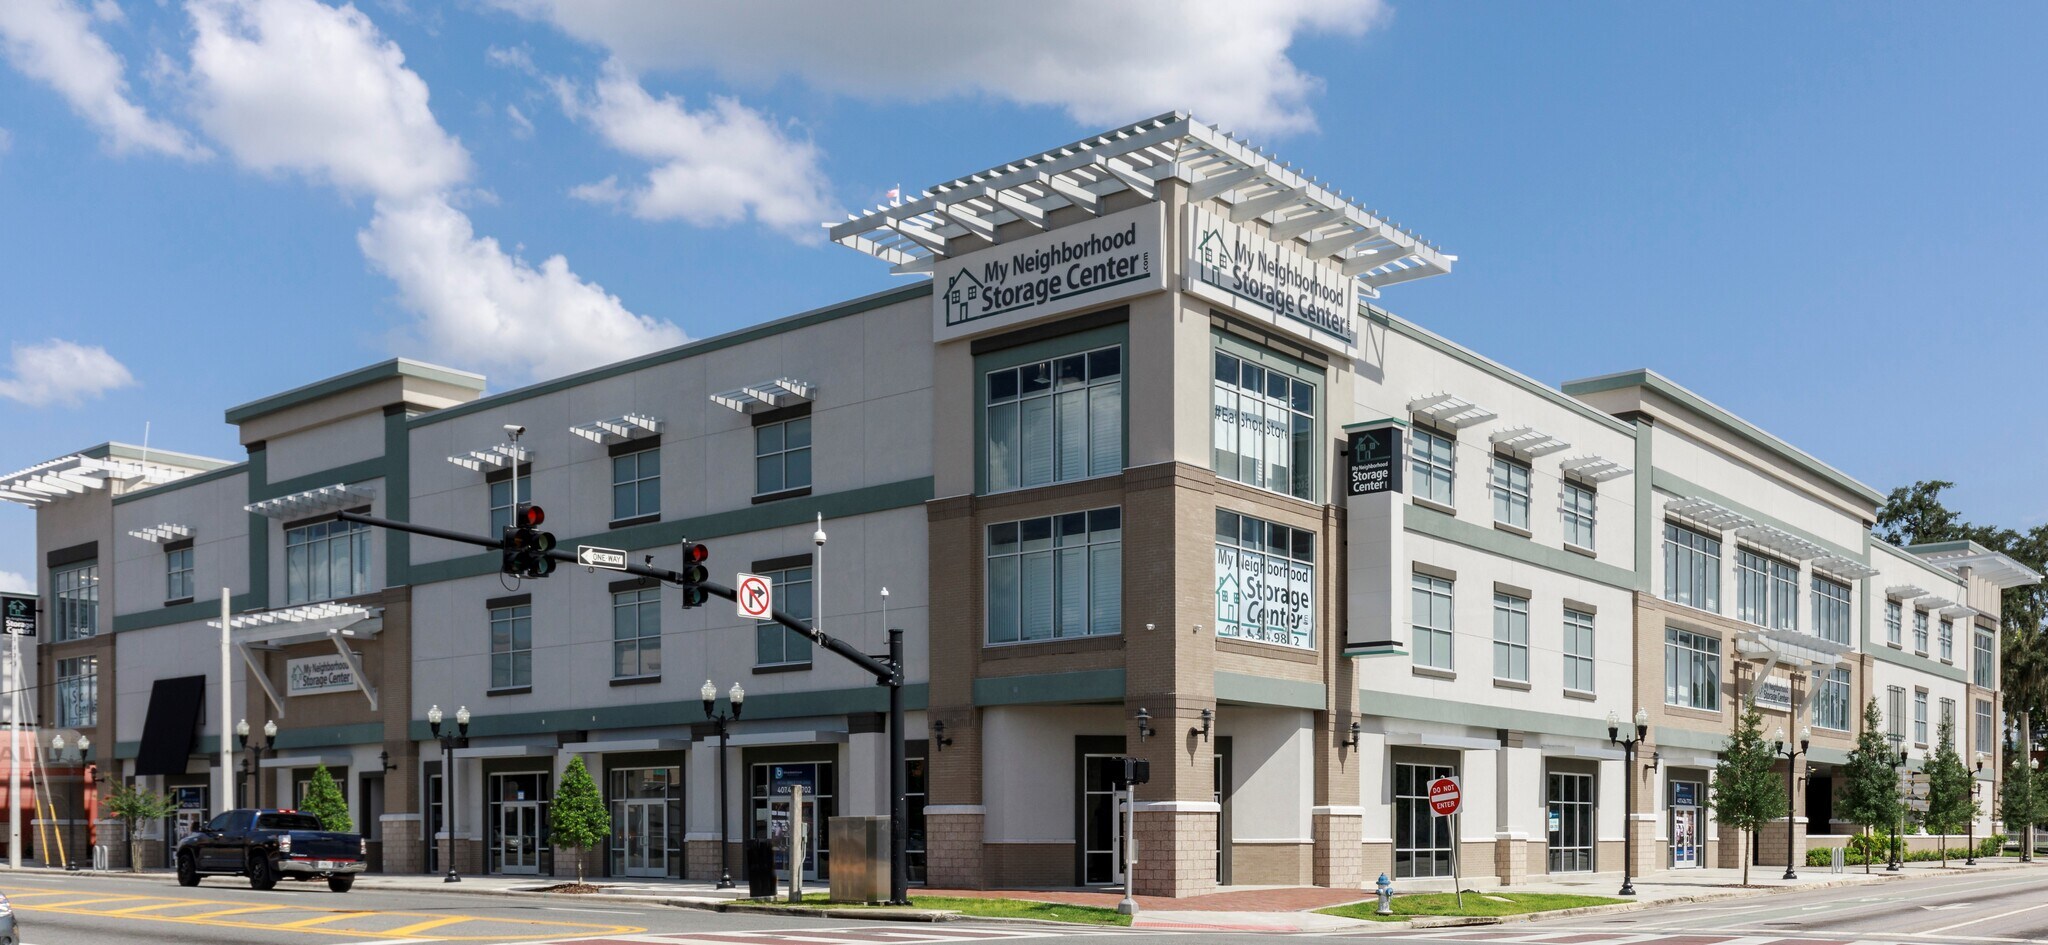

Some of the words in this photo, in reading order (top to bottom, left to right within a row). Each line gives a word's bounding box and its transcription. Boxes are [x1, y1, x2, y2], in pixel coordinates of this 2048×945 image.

[984, 260, 1009, 285] My
[1012, 222, 1136, 277] Neighborhood
[1235, 240, 1255, 273] My
[1258, 250, 1344, 308] Neighborhood
[982, 271, 1062, 313] Storage
[1066, 253, 1139, 290] Center
[1232, 264, 1295, 315] Storage
[1298, 294, 1346, 334] Center
[1358, 461, 1389, 471] Neighborhood
[1352, 469, 1389, 482] Storage
[1353, 480, 1384, 493] Center
[608, 555, 621, 563] WAY
[1217, 548, 1234, 570] My
[1246, 576, 1309, 613] Storage
[303, 675, 327, 687] Storage
[329, 672, 351, 684] Center
[1443, 784, 1455, 792] NOT
[1437, 801, 1455, 809] ENTER
